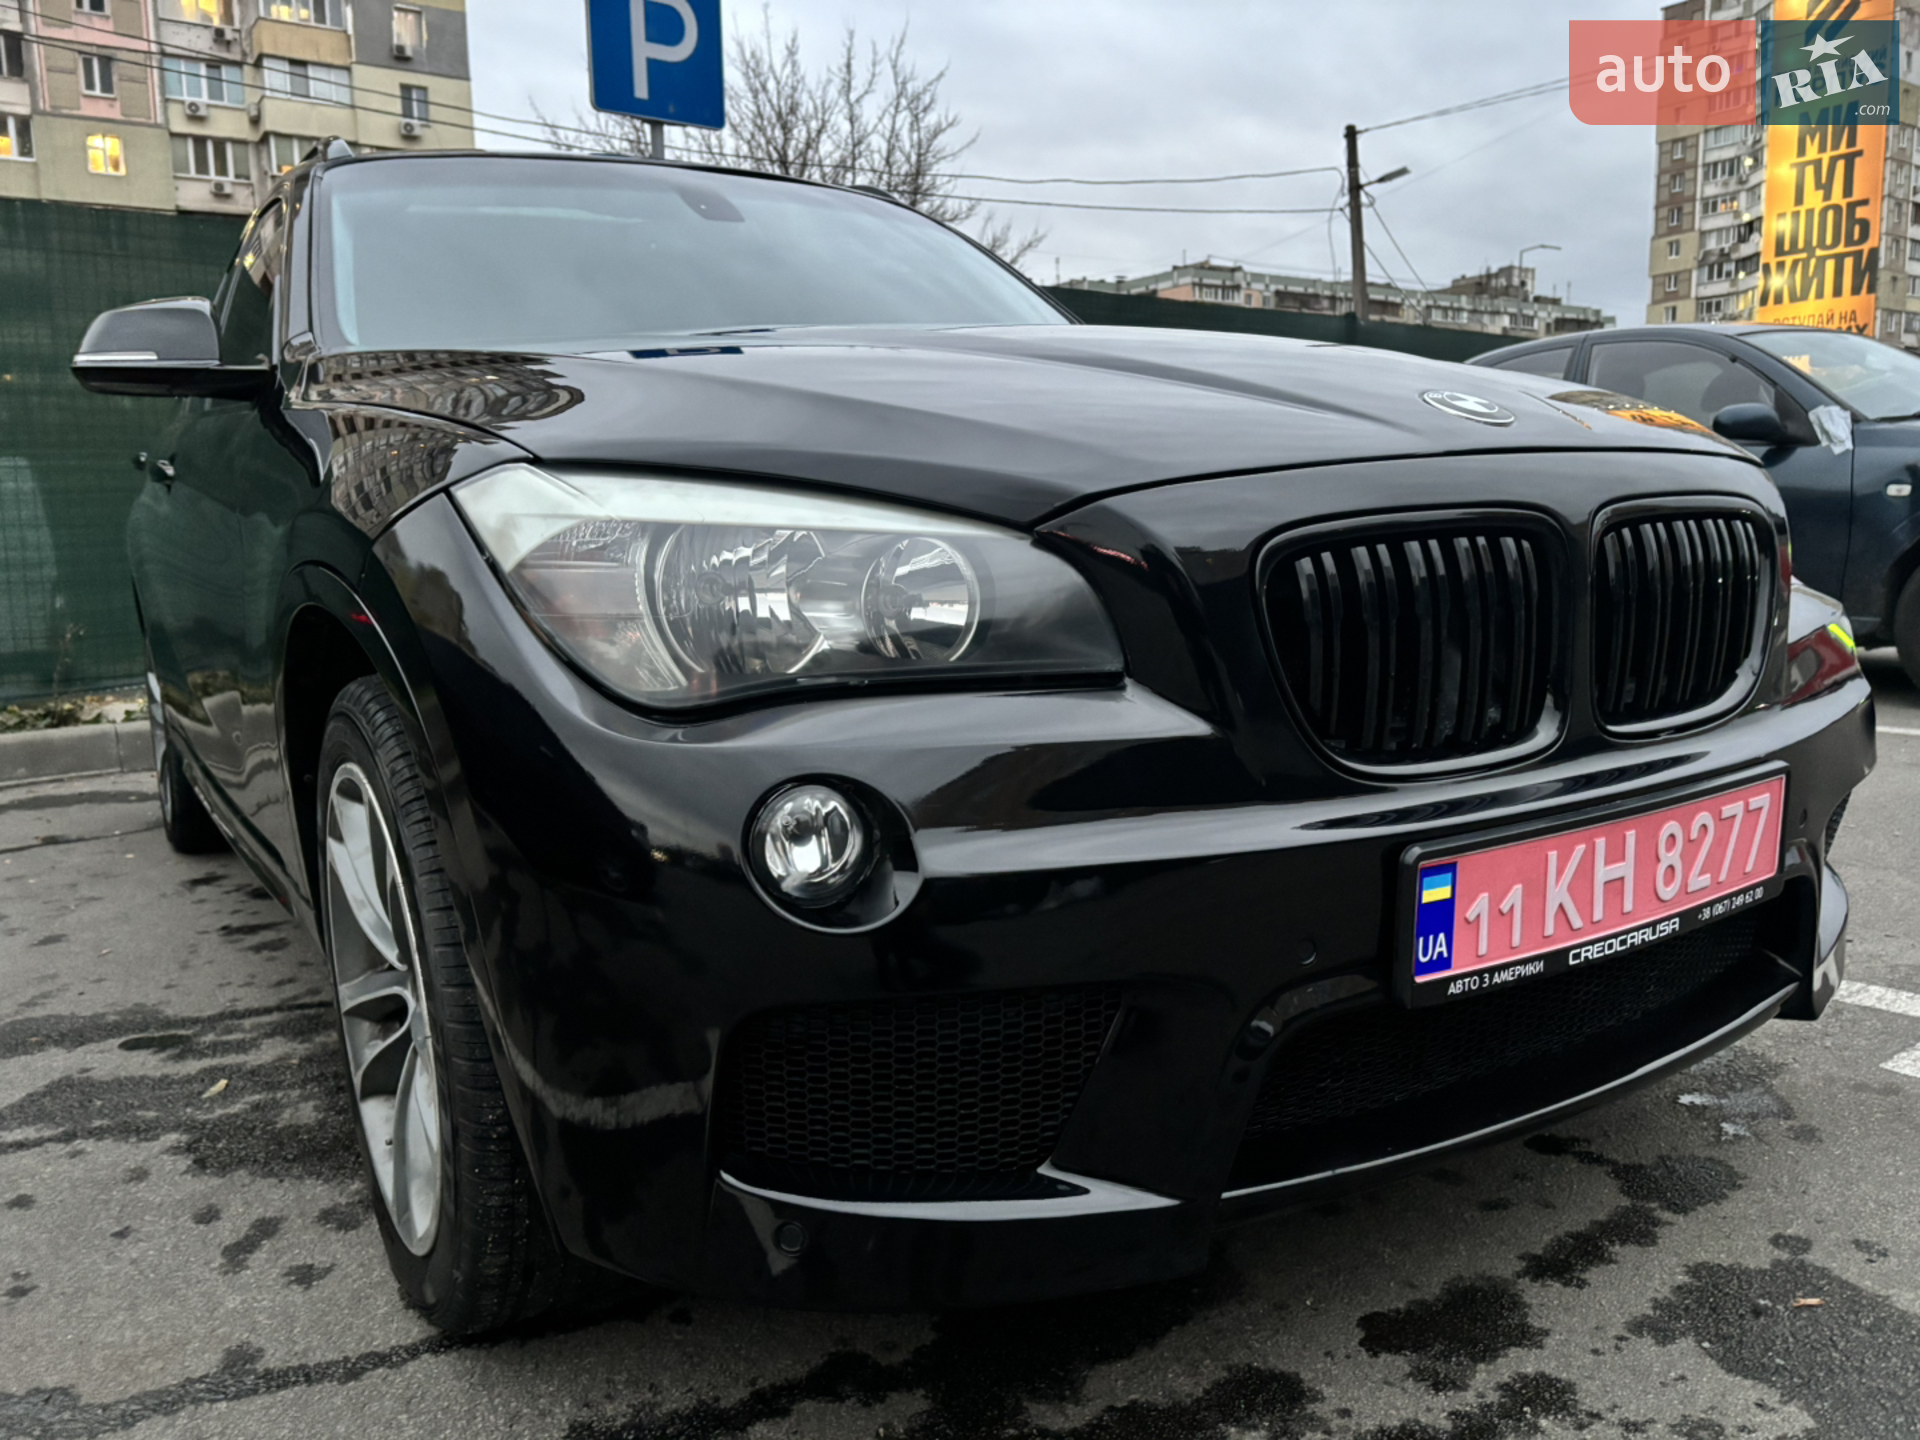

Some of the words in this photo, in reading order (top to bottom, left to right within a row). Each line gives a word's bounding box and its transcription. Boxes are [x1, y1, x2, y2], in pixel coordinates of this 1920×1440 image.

[629, 0, 699, 100] P
[1797, 100, 1859, 158] МИ
[1790, 149, 1864, 207] ТУТ
[1774, 198, 1871, 258] ЩОБ
[1759, 247, 1880, 307] ЖИТИ
[1839, 309, 1857, 324] НА
[1464, 884, 1523, 957] 11
[1542, 829, 1637, 938] KH
[1654, 792, 1771, 902] 8277
[1416, 932, 1448, 964] UA
[1568, 917, 1680, 966] CREOCARUSA
[1447, 975, 1479, 996] АВТО
[1491, 960, 1544, 985] АМЕРИКИ
